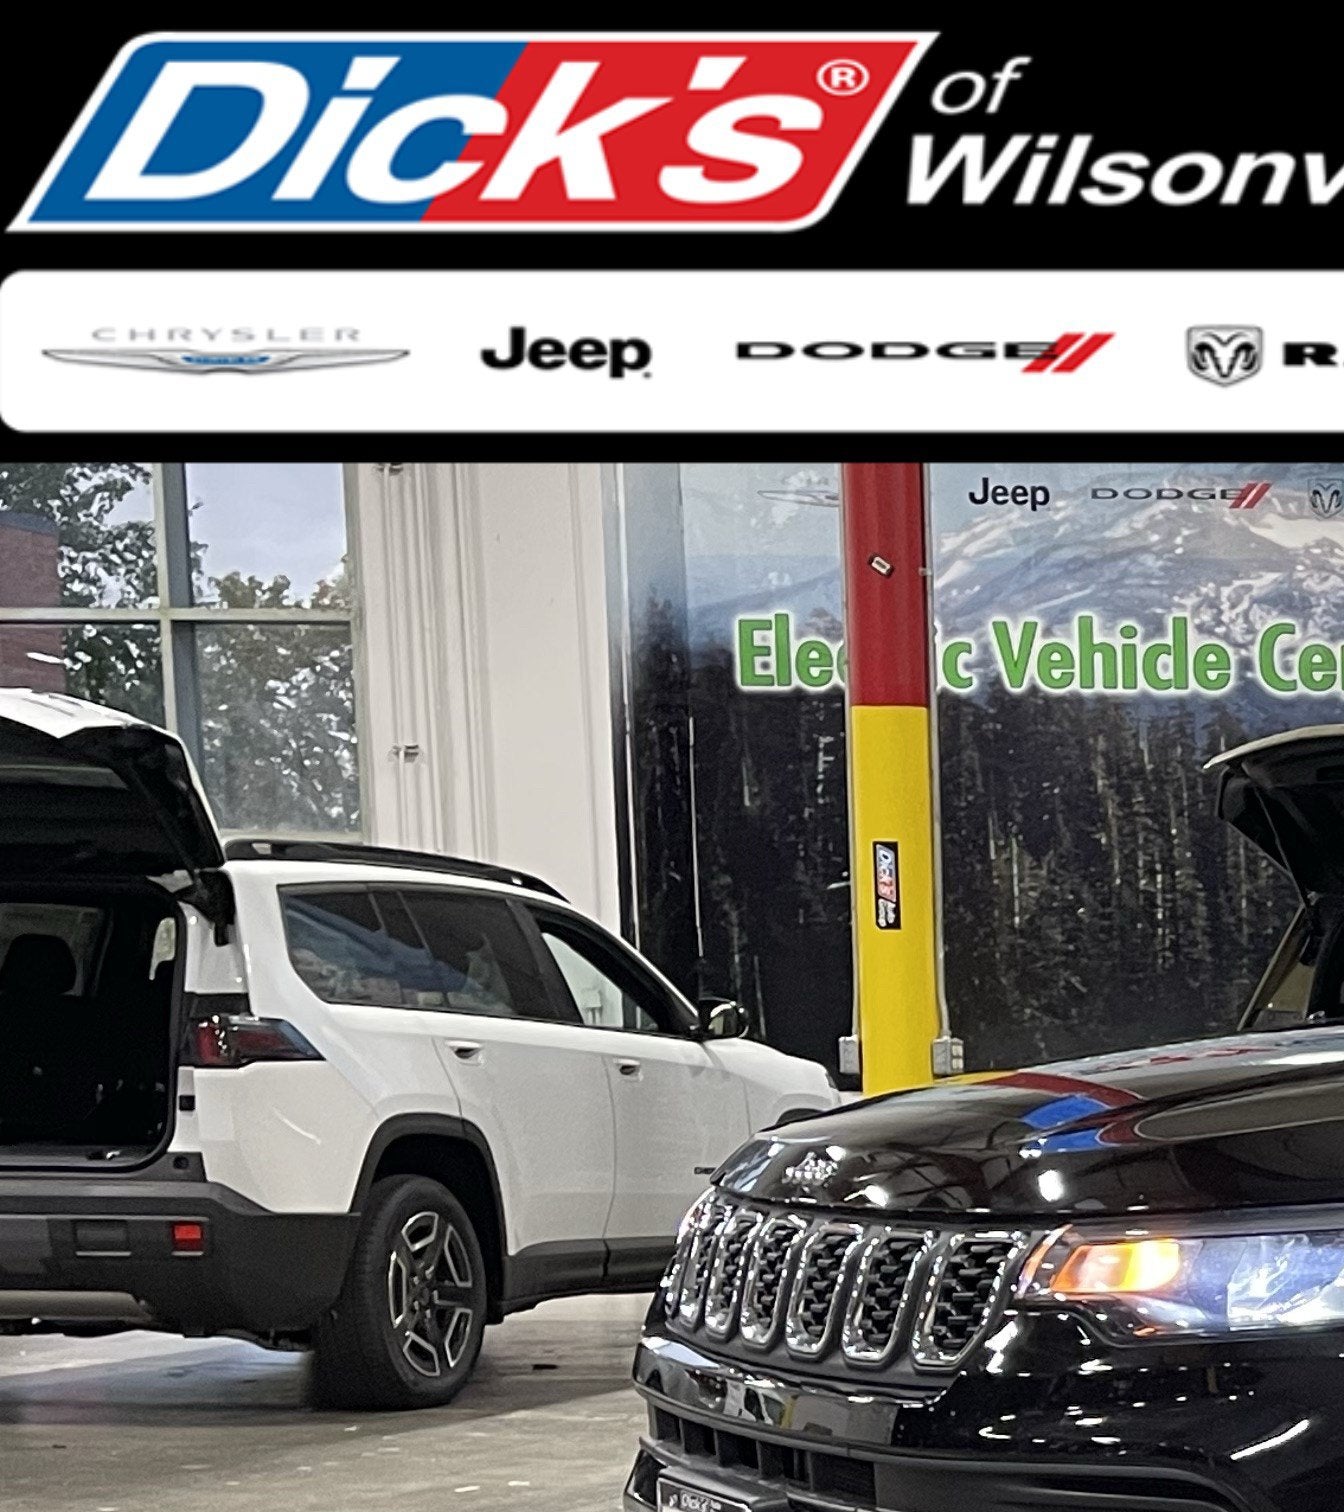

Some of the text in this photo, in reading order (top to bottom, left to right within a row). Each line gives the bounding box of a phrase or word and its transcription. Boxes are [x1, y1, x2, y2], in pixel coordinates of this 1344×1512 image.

[968, 477, 1050, 512] Jeep
[1091, 486, 1243, 500] DODGE
[738, 612, 974, 690] Elec
[992, 614, 1232, 691] Vehicle
